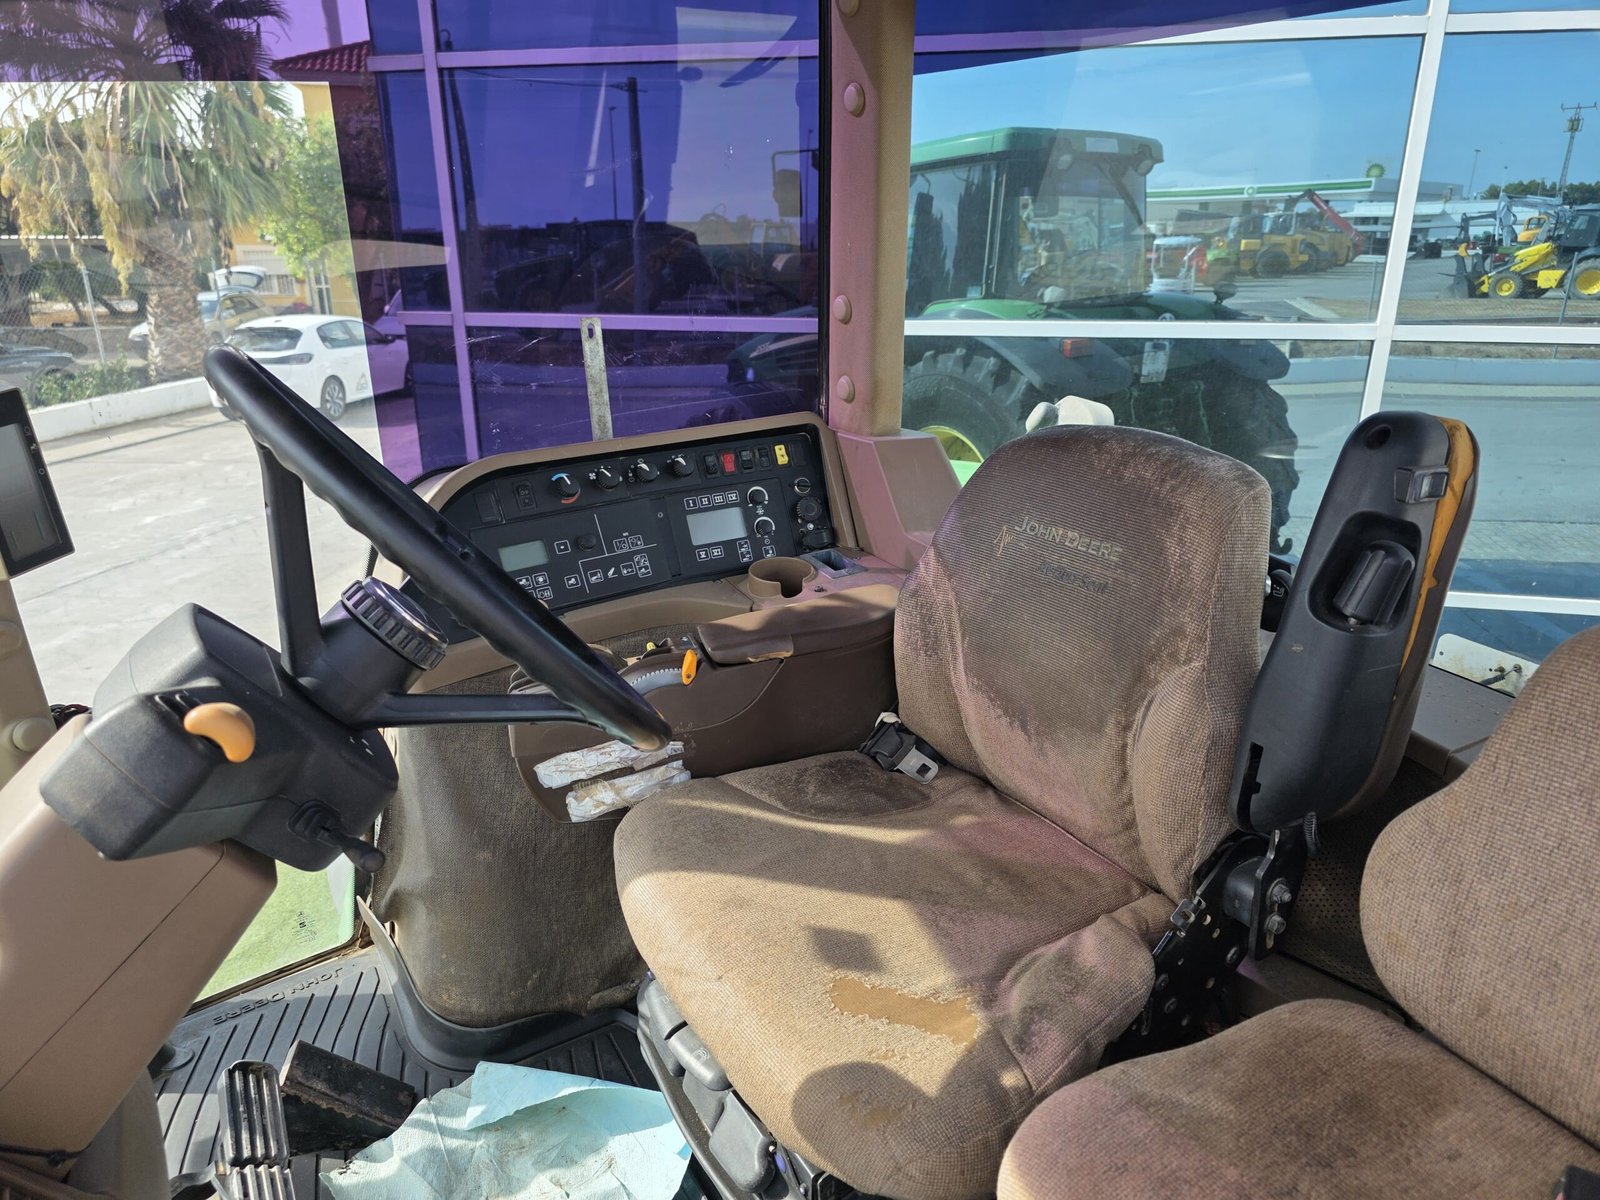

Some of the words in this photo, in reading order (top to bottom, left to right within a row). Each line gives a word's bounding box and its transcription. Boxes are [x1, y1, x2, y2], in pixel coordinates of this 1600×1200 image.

[714, 495, 724, 503] III
[728, 493, 737, 501] IV
[712, 548, 722, 556] VI
[1014, 516, 1062, 544] JOHN
[1065, 530, 1123, 561] DEERE
[290, 966, 344, 995] JOHN
[212, 991, 286, 1026] DEERE
